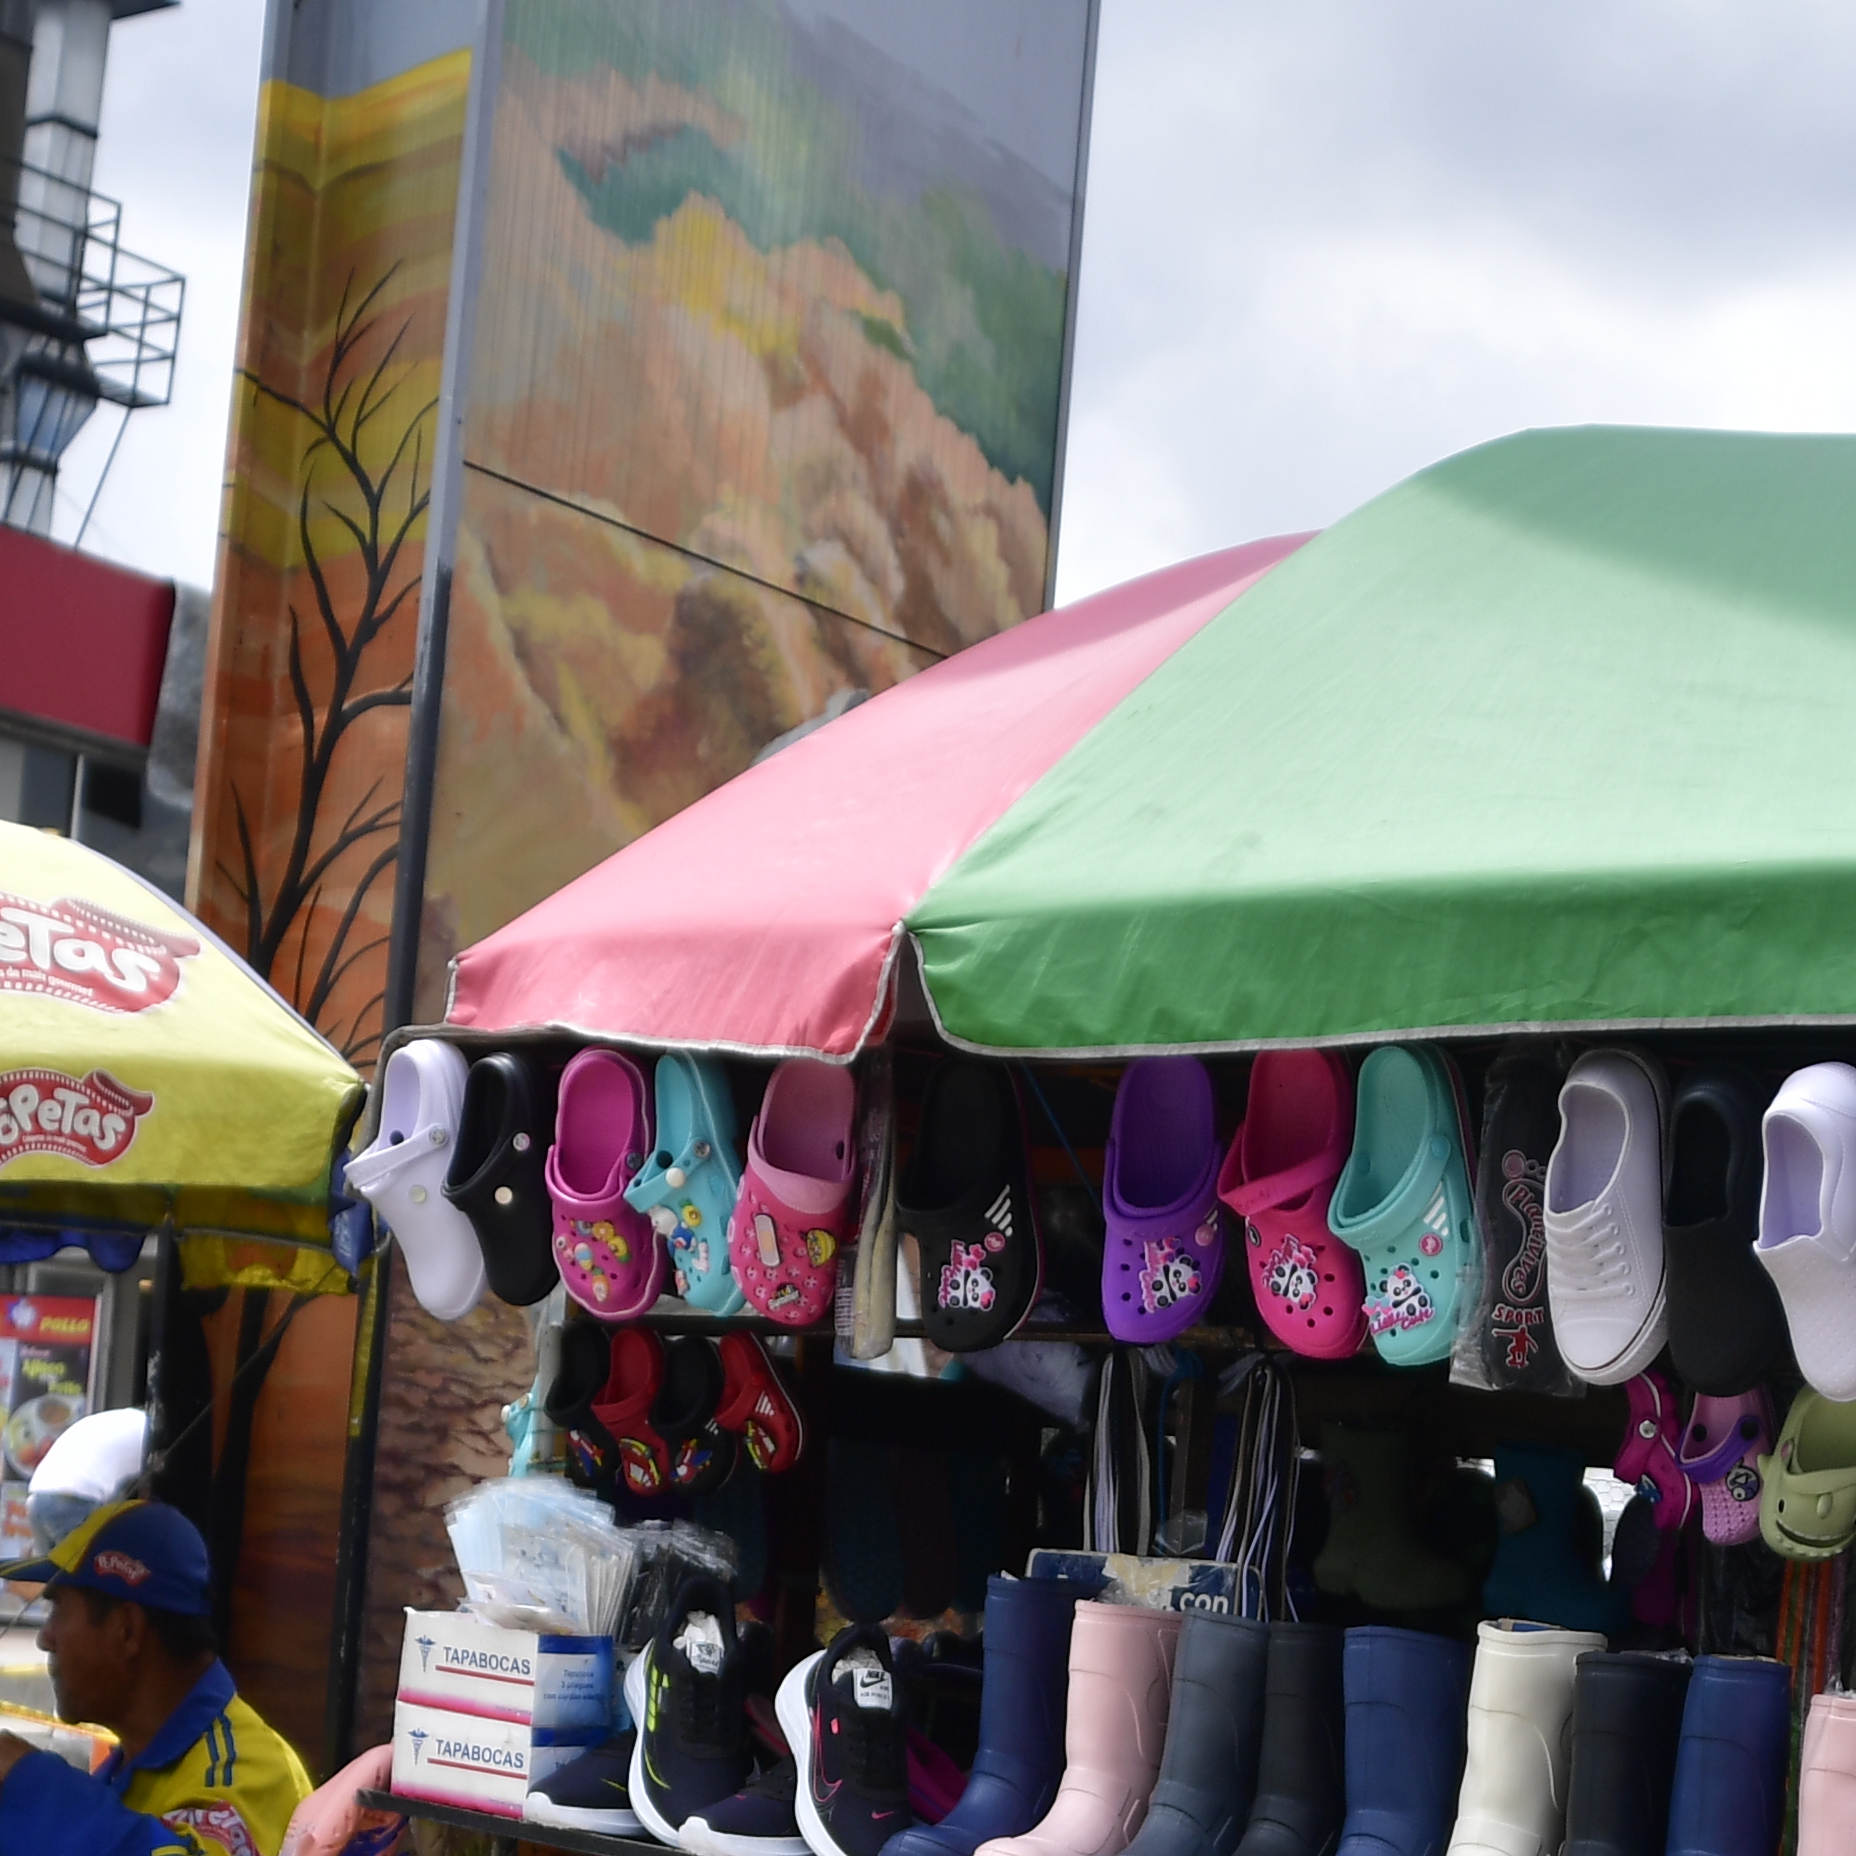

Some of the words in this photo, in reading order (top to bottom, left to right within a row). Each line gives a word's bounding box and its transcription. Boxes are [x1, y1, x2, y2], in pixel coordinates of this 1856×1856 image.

[1493, 1303, 1544, 1324] SPORT
[443, 1646, 531, 1676] TAPABOCAS
[436, 1738, 525, 1769] TAPABOCAS
